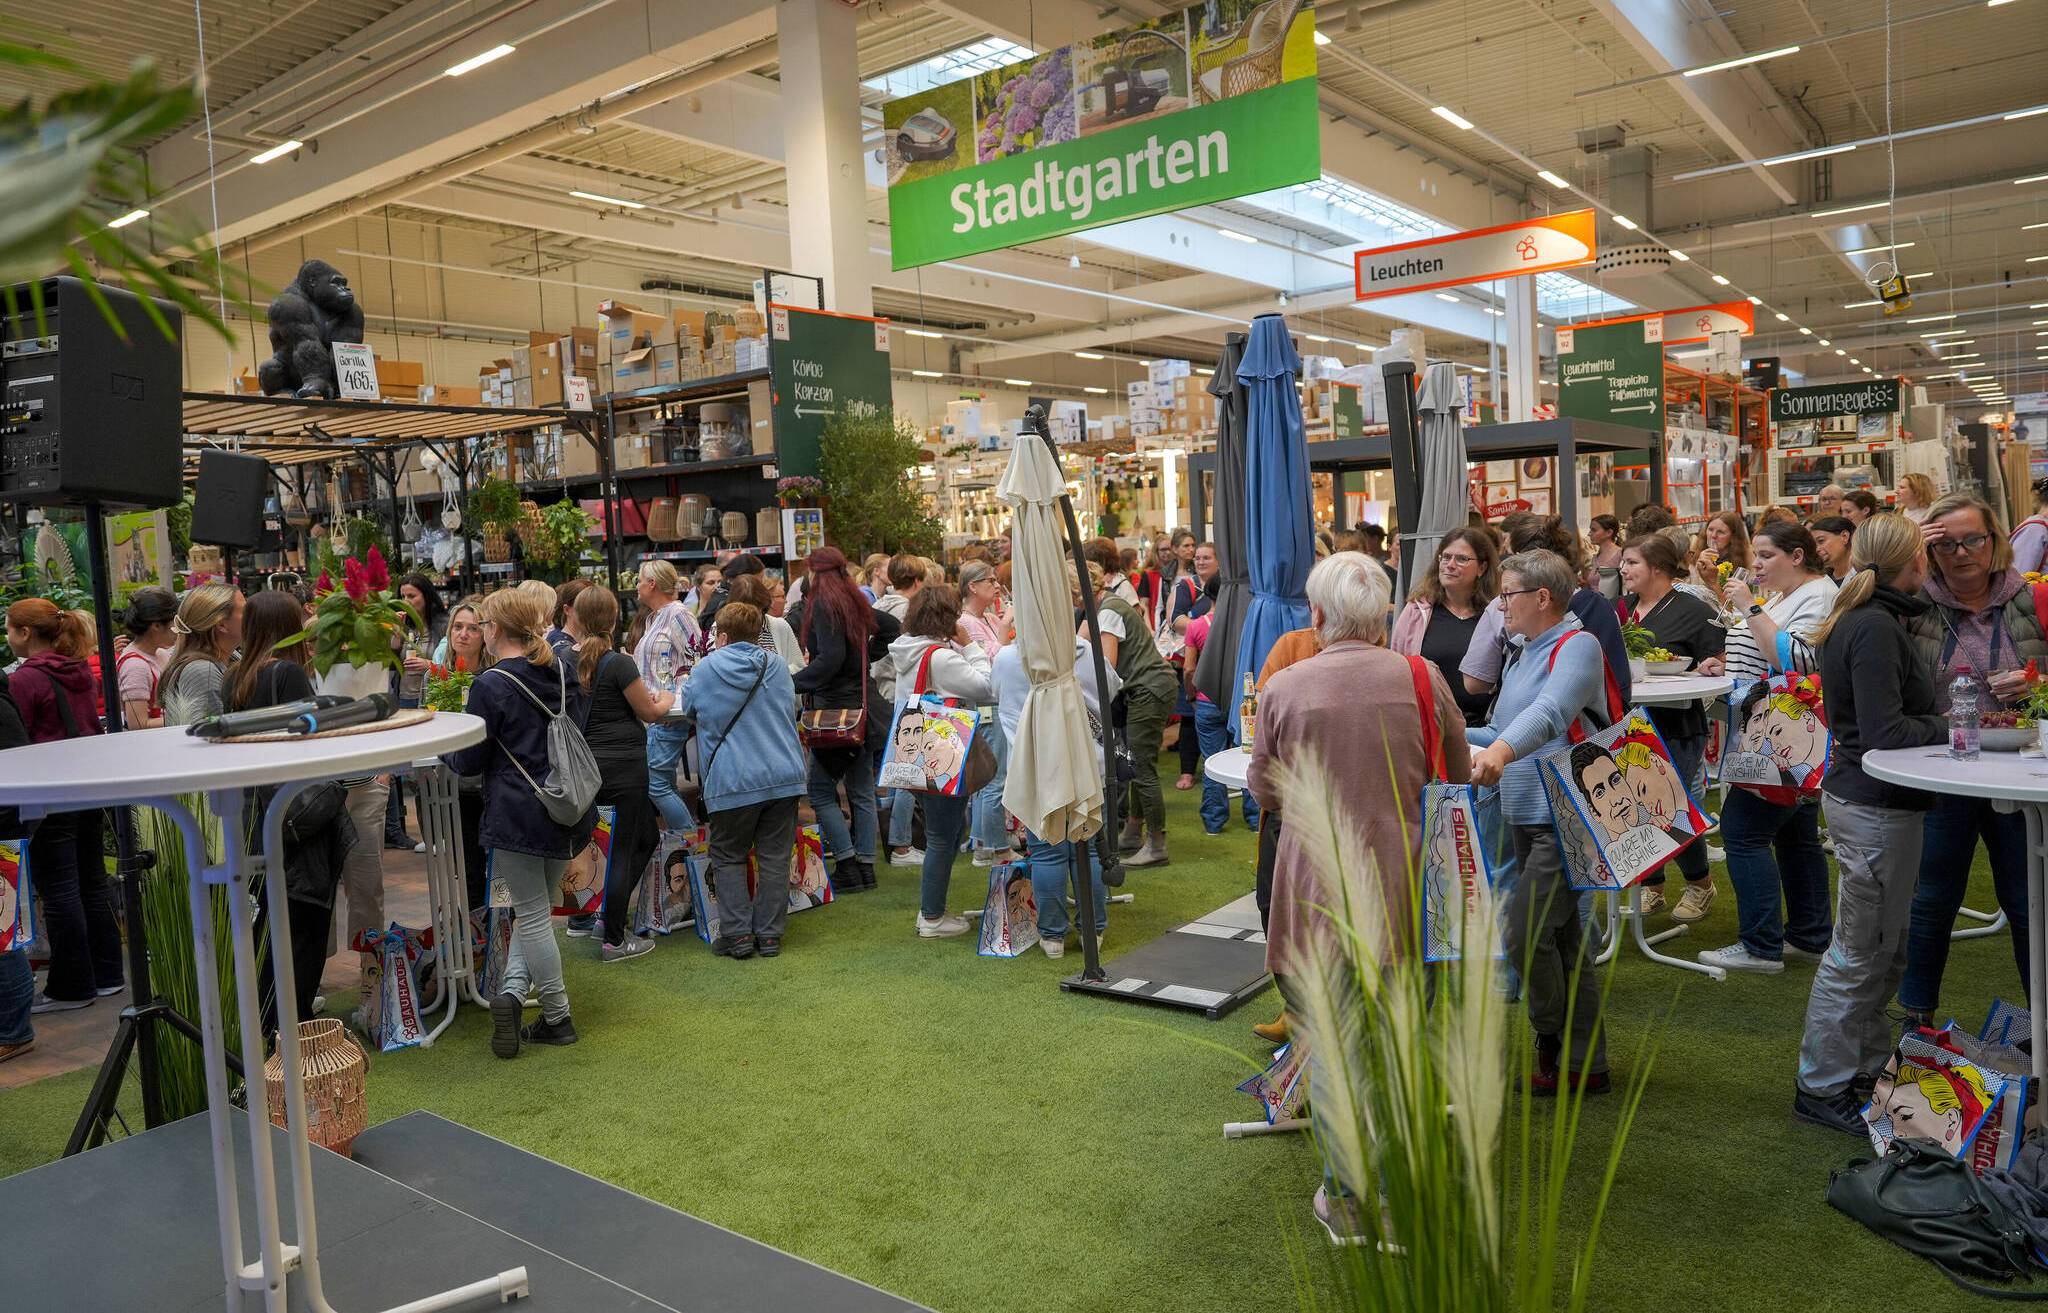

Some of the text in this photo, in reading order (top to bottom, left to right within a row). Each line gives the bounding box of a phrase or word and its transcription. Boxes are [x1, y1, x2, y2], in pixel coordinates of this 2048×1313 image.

[951, 130, 1229, 233] Stadtgarten
[1371, 257, 1444, 282] Leuchten
[776, 323, 785, 332] 25
[339, 355, 367, 368] Gorilla
[792, 359, 824, 378] Körbe
[1563, 358, 1615, 376] Leuchtmittel
[1607, 374, 1649, 388] Teppiche
[575, 393, 585, 402] 27
[794, 382, 833, 402] Kerzen
[1608, 386, 1658, 402] Fußmatten
[1780, 384, 1874, 415] Sonnensegel
[1755, 757, 1770, 769] MY
[1621, 834, 1641, 856] ARE
[1639, 825, 1656, 844] MY
[395, 956, 418, 1029] BAUHAUS
